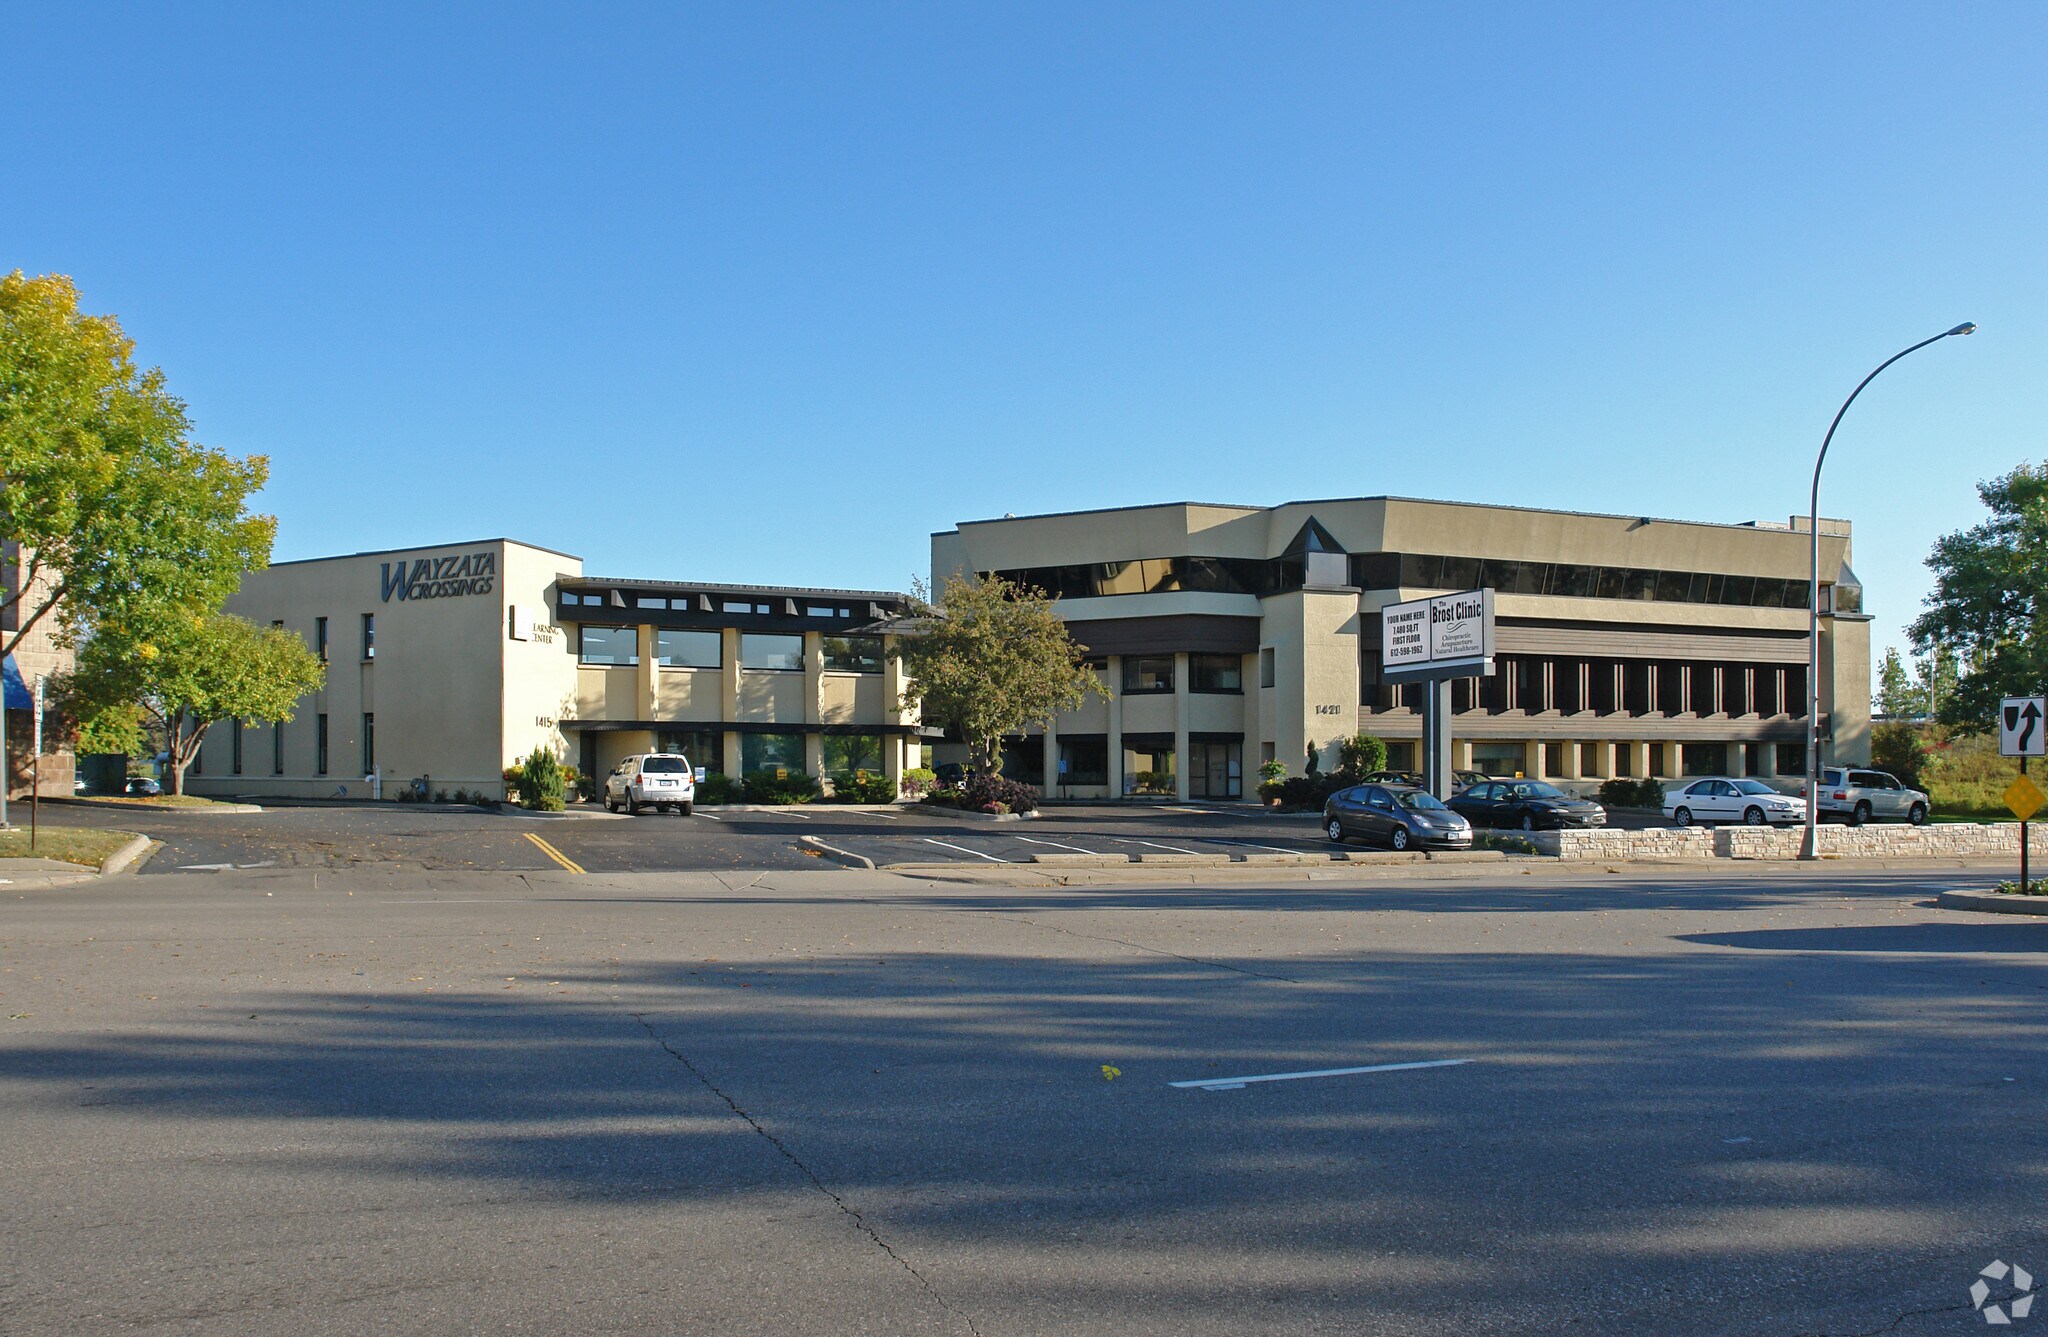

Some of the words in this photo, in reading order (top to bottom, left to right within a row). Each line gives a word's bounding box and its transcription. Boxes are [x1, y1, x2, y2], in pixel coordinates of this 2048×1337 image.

[380, 552, 496, 603] WAYZATA
[408, 576, 494, 600] CROSSINGS
[1387, 614, 1399, 624] YOUR
[1400, 612, 1413, 622] NAME
[1413, 610, 1425, 620] HERE
[1432, 605, 1455, 624] Brost
[1456, 599, 1482, 620] Clinic
[531, 632, 553, 645] ENTER
[1392, 635, 1406, 646] FIRST
[1406, 633, 1421, 644] FLOOR
[1441, 632, 1472, 642] Chiropractic
[1434, 646, 1453, 655] Natural
[1453, 645, 1479, 653] Healthcare
[1440, 639, 1473, 649] Acupuncture
[1315, 704, 1341, 715] 1421
[535, 715, 552, 728] 1415
